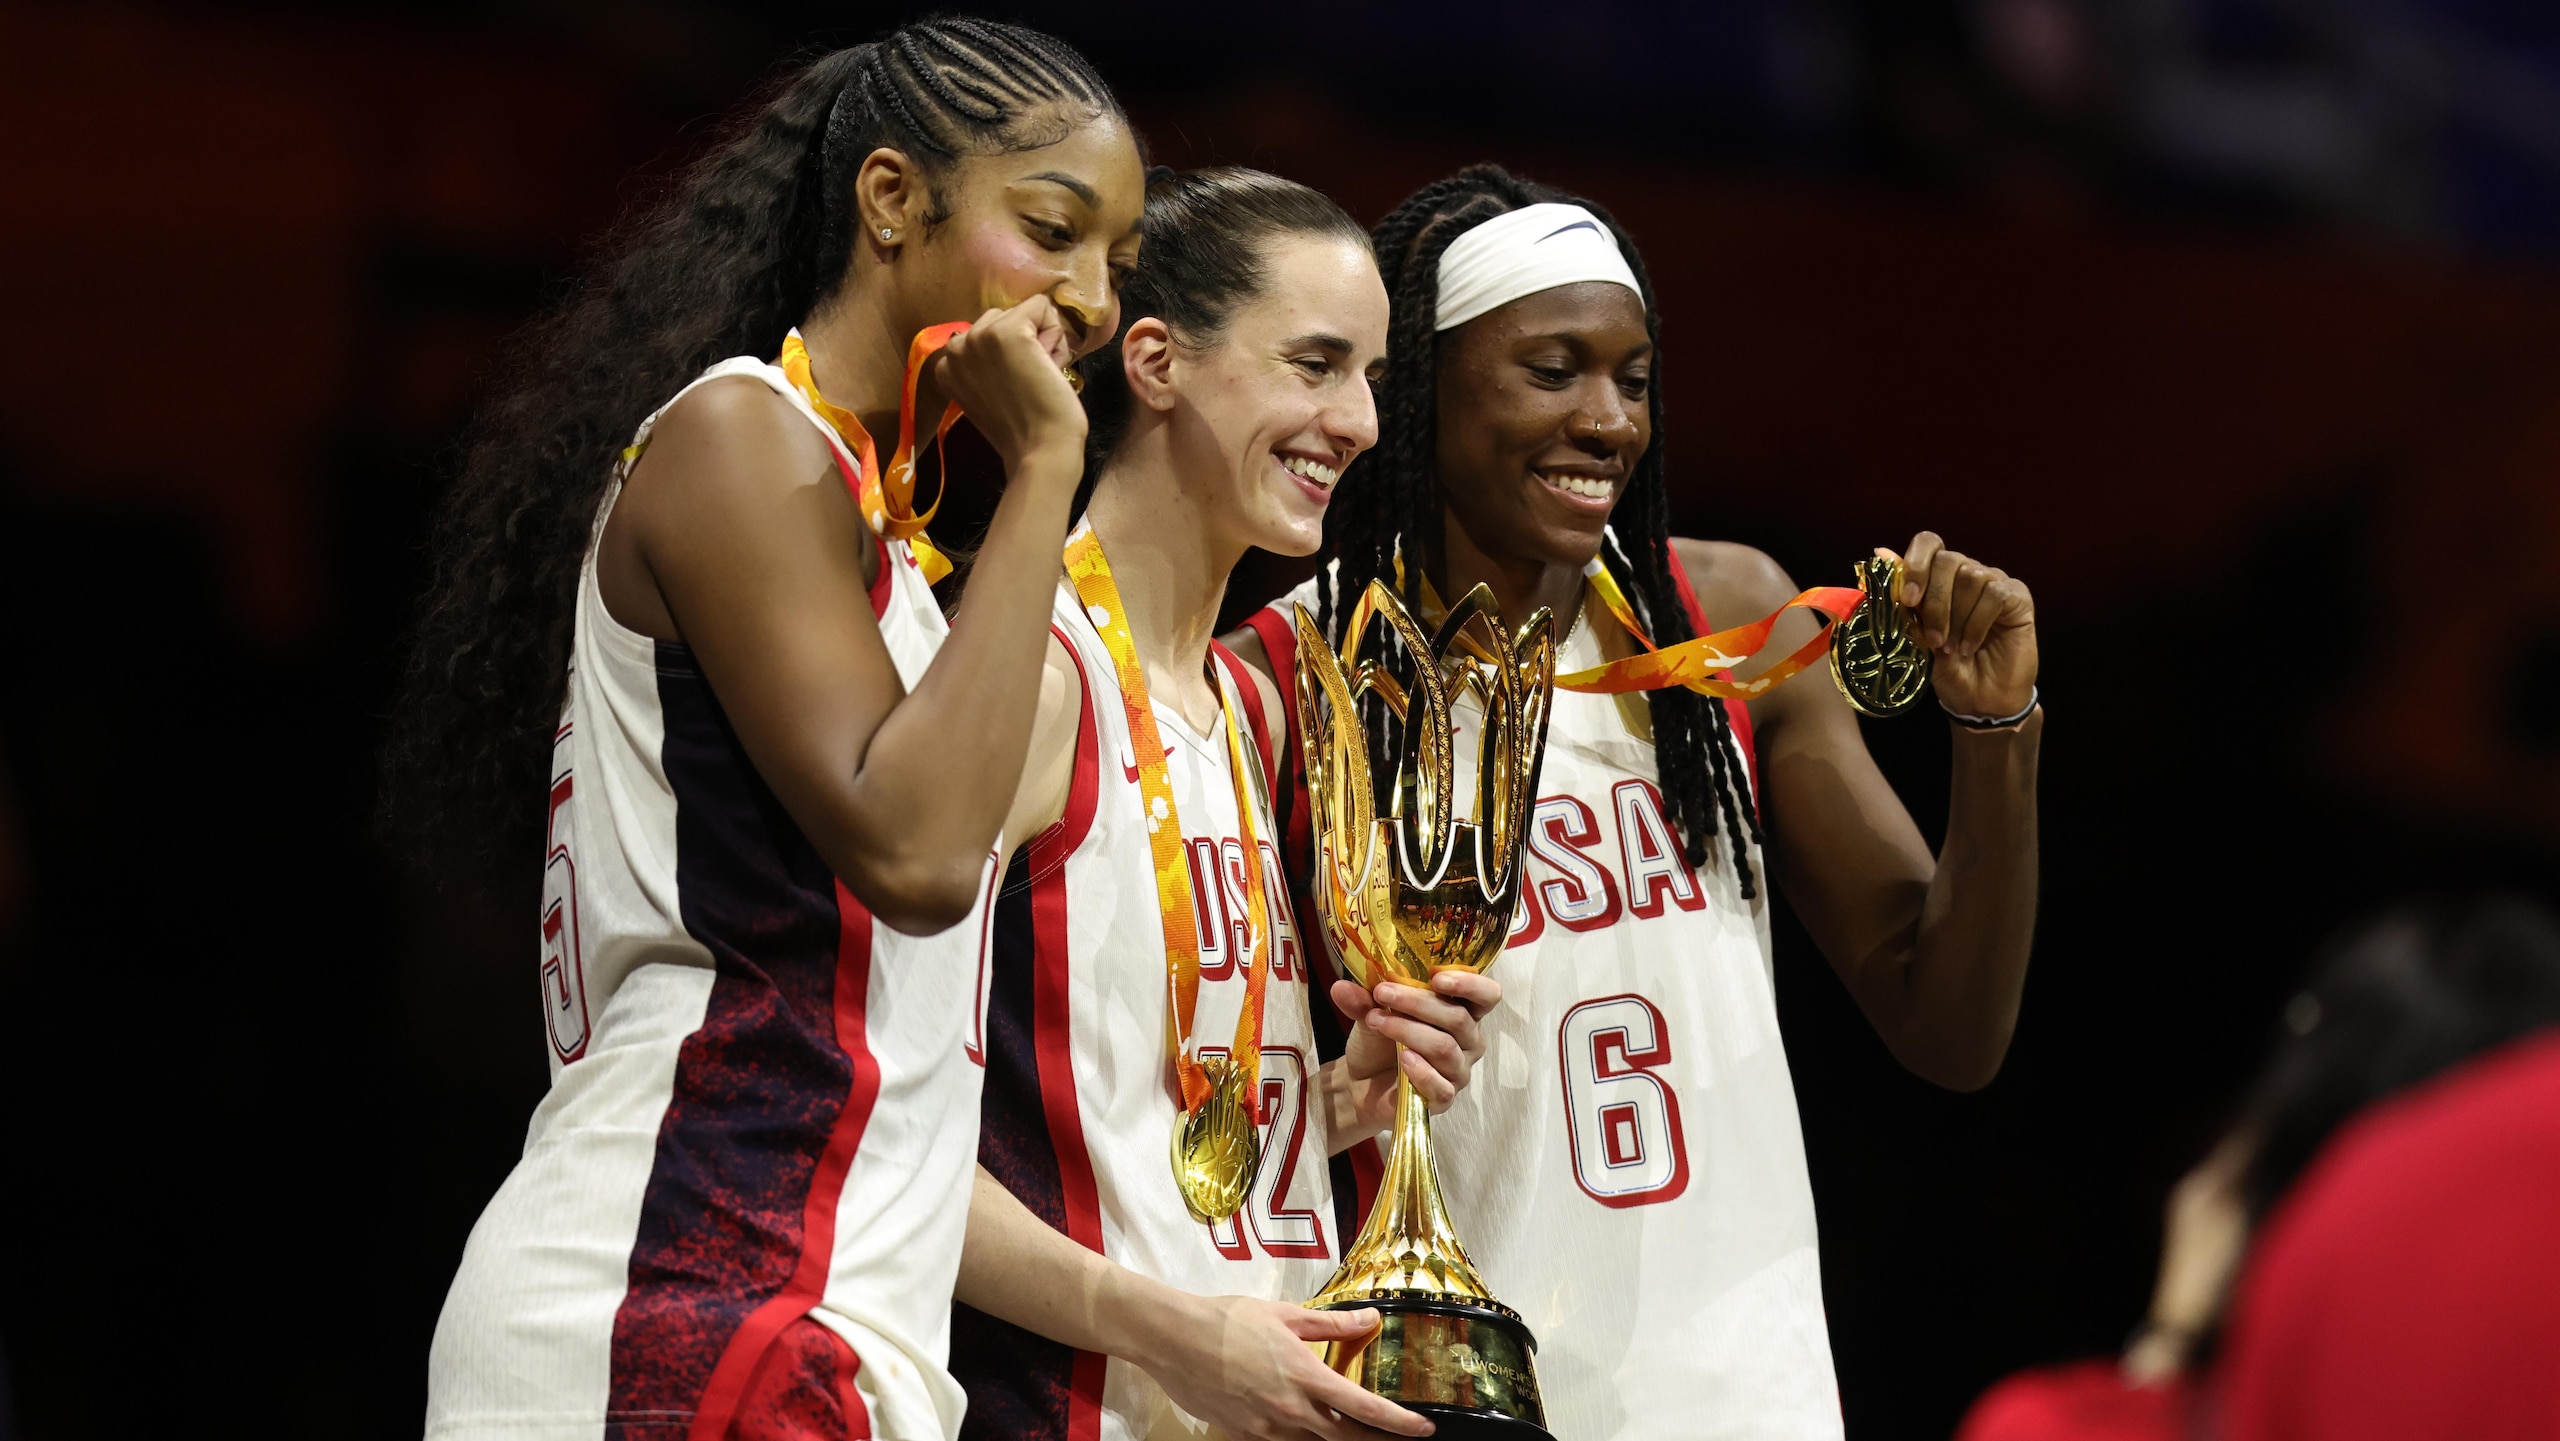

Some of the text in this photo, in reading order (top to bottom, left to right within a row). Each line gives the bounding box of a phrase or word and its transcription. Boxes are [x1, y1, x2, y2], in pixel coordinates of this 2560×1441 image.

[1183, 837, 1308, 982] USA
[1505, 778, 1706, 950] SA
[1558, 993, 1691, 1209] 6
[1475, 1358, 1532, 1388] WOMEN'S
